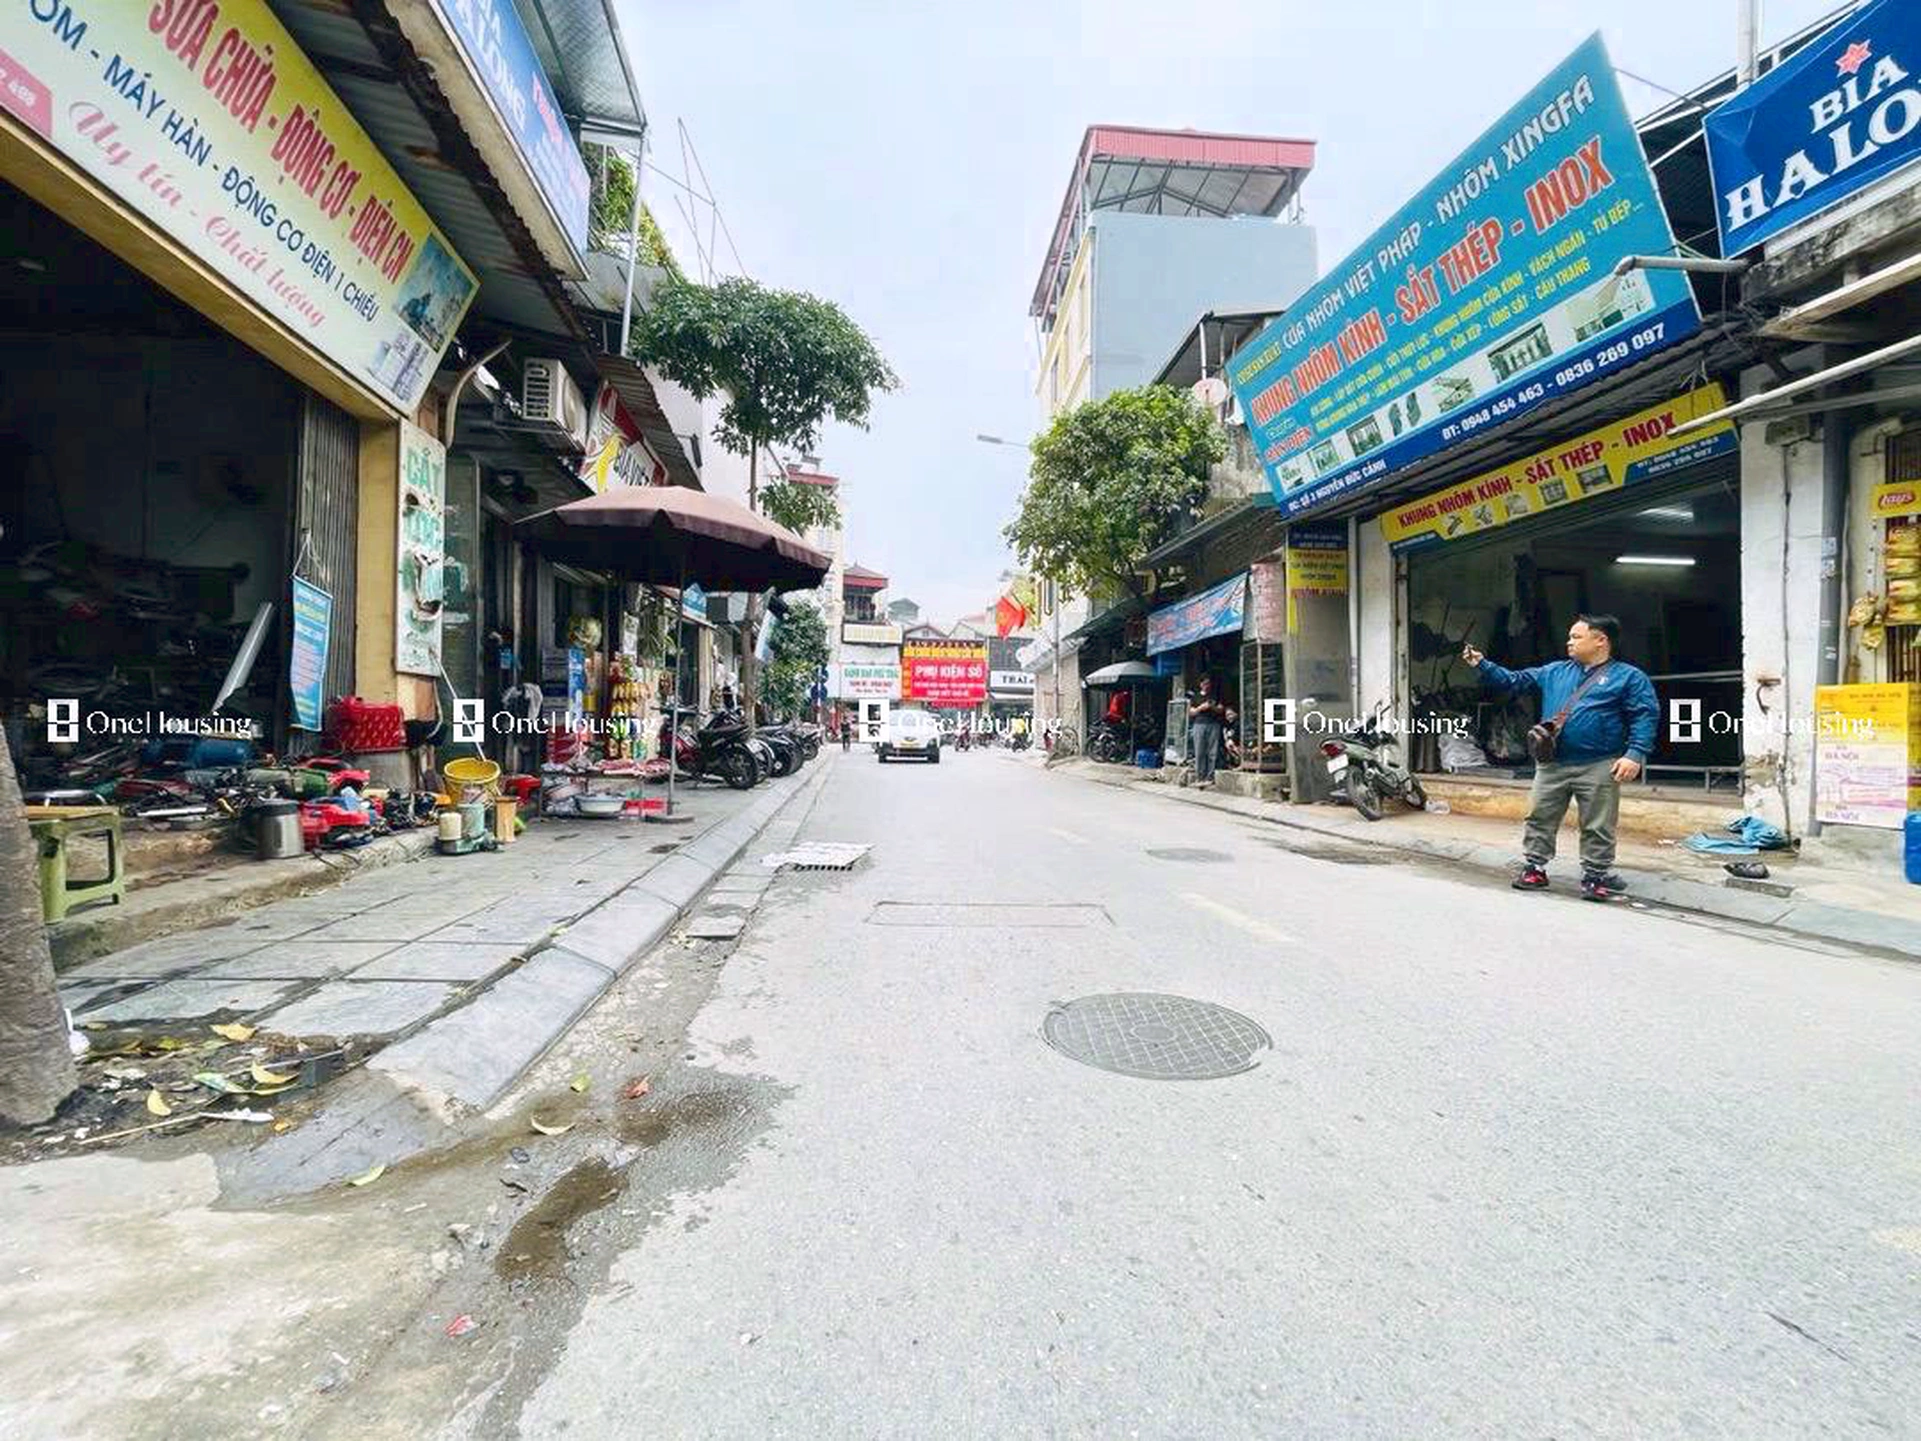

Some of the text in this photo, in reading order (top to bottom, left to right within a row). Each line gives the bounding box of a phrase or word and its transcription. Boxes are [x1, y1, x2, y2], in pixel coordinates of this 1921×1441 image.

[103, 54, 166, 119] MÁY
[161, 109, 213, 166] HÀN
[222, 166, 278, 228] ĐỘNG
[276, 219, 305, 252] CƠ
[302, 242, 337, 285] ĐIỆN
[1724, 79, 1921, 233] HALO
[1809, 53, 1909, 134] BIA
[205, 215, 269, 273] Chất
[271, 104, 337, 199] ĐỘNG
[320, 160, 363, 221] CƠ
[350, 194, 399, 267] ĐIỆN
[381, 229, 416, 285] CN
[1344, 260, 1377, 299] VIỆT
[1378, 221, 1421, 274] PHÁP
[1436, 156, 1500, 225] NHÔM
[1501, 73, 1595, 171] XINGFA
[1252, 373, 1298, 426] KHUNG
[1292, 341, 1345, 397] NHÔM
[1337, 306, 1388, 368] KÍNH
[1395, 263, 1441, 325] SẮT
[1437, 217, 1503, 295] THÉP
[1524, 134, 1616, 236] INOX
[1460, 406, 1492, 432] 0948
[1491, 396, 1518, 416] 454
[1517, 382, 1545, 407] 463
[1555, 358, 1595, 388] 0836
[1596, 340, 1631, 368] 269
[1631, 321, 1667, 351] 097
[1396, 502, 1438, 529] KHUNG
[1437, 487, 1478, 518] NHÔM
[1476, 474, 1514, 503] KÍNH
[1523, 458, 1557, 486] SẮT
[1559, 439, 1606, 473] THÉP
[1621, 411, 1677, 449] INOX
